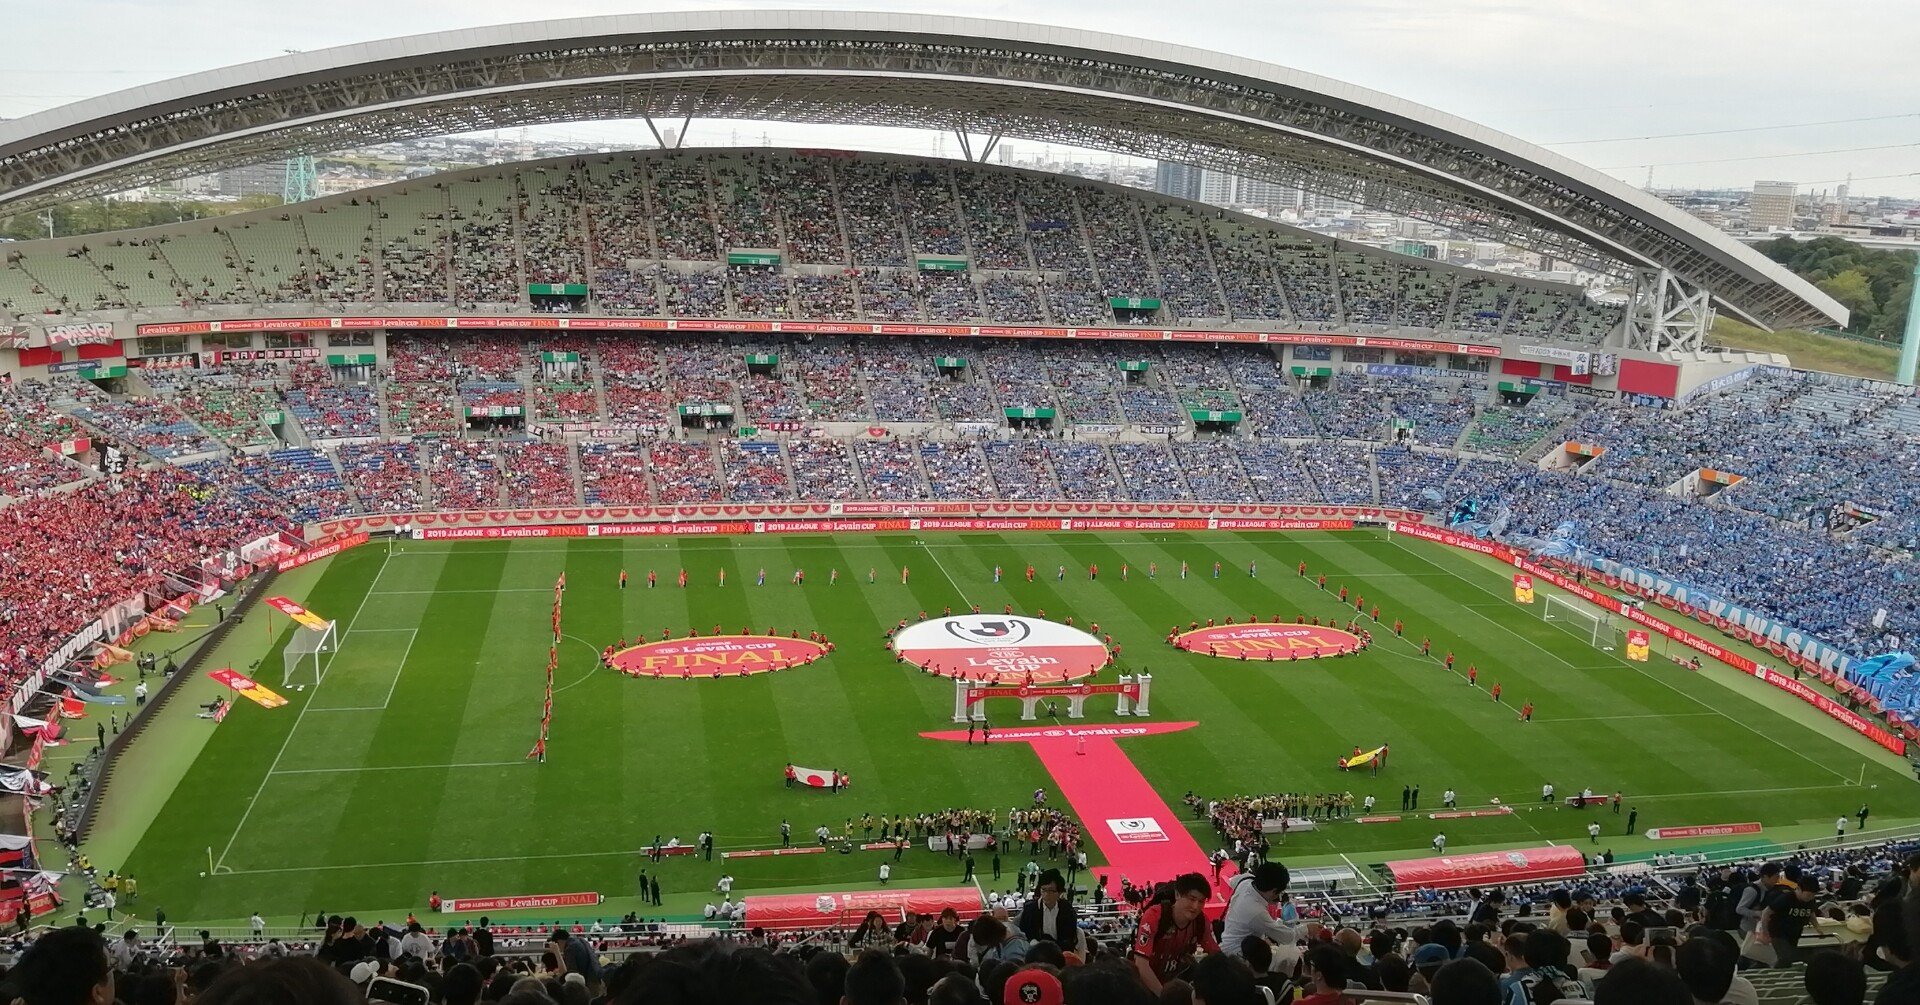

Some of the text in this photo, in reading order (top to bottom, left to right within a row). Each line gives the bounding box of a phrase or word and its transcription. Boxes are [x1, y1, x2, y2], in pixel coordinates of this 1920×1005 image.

[46, 322, 114, 344] FOREVER
[672, 524, 704, 533] Levain
[720, 523, 751, 531] FINA
[834, 521, 862, 529] Levain
[879, 521, 907, 529] FINAL
[986, 520, 1012, 528] Levain
[501, 528, 532, 536] Levain
[552, 526, 583, 535] FINAL
[1399, 526, 1415, 534] 2019
[1415, 529, 1442, 541] J.LEAGUE
[1457, 537, 1481, 551] Levain
[1481, 545, 1494, 553] CUP
[307, 548, 329, 561] Levain
[329, 544, 340, 554] CUP
[343, 533, 367, 548] FINAL
[1603, 560, 1848, 679] FORZA KAWASAKI
[1202, 637, 1344, 652] FINAL
[1632, 611, 1645, 621] 2019
[1684, 633, 1708, 650] Levain
[1708, 645, 1721, 657] CUP
[1725, 652, 1752, 671] FINAL
[682, 644, 743, 653] Levain
[642, 650, 798, 669] FINAL
[966, 655, 1059, 666] Levain
[988, 671, 1060, 680] FINAL
[1769, 673, 1898, 751] 2019 J.LEAGUE Levain CUP FINAL
[510, 897, 541, 908] Levain
[542, 898, 558, 906] CUP
[560, 895, 592, 905] FINAL
[1164, 960, 1177, 972] 18
